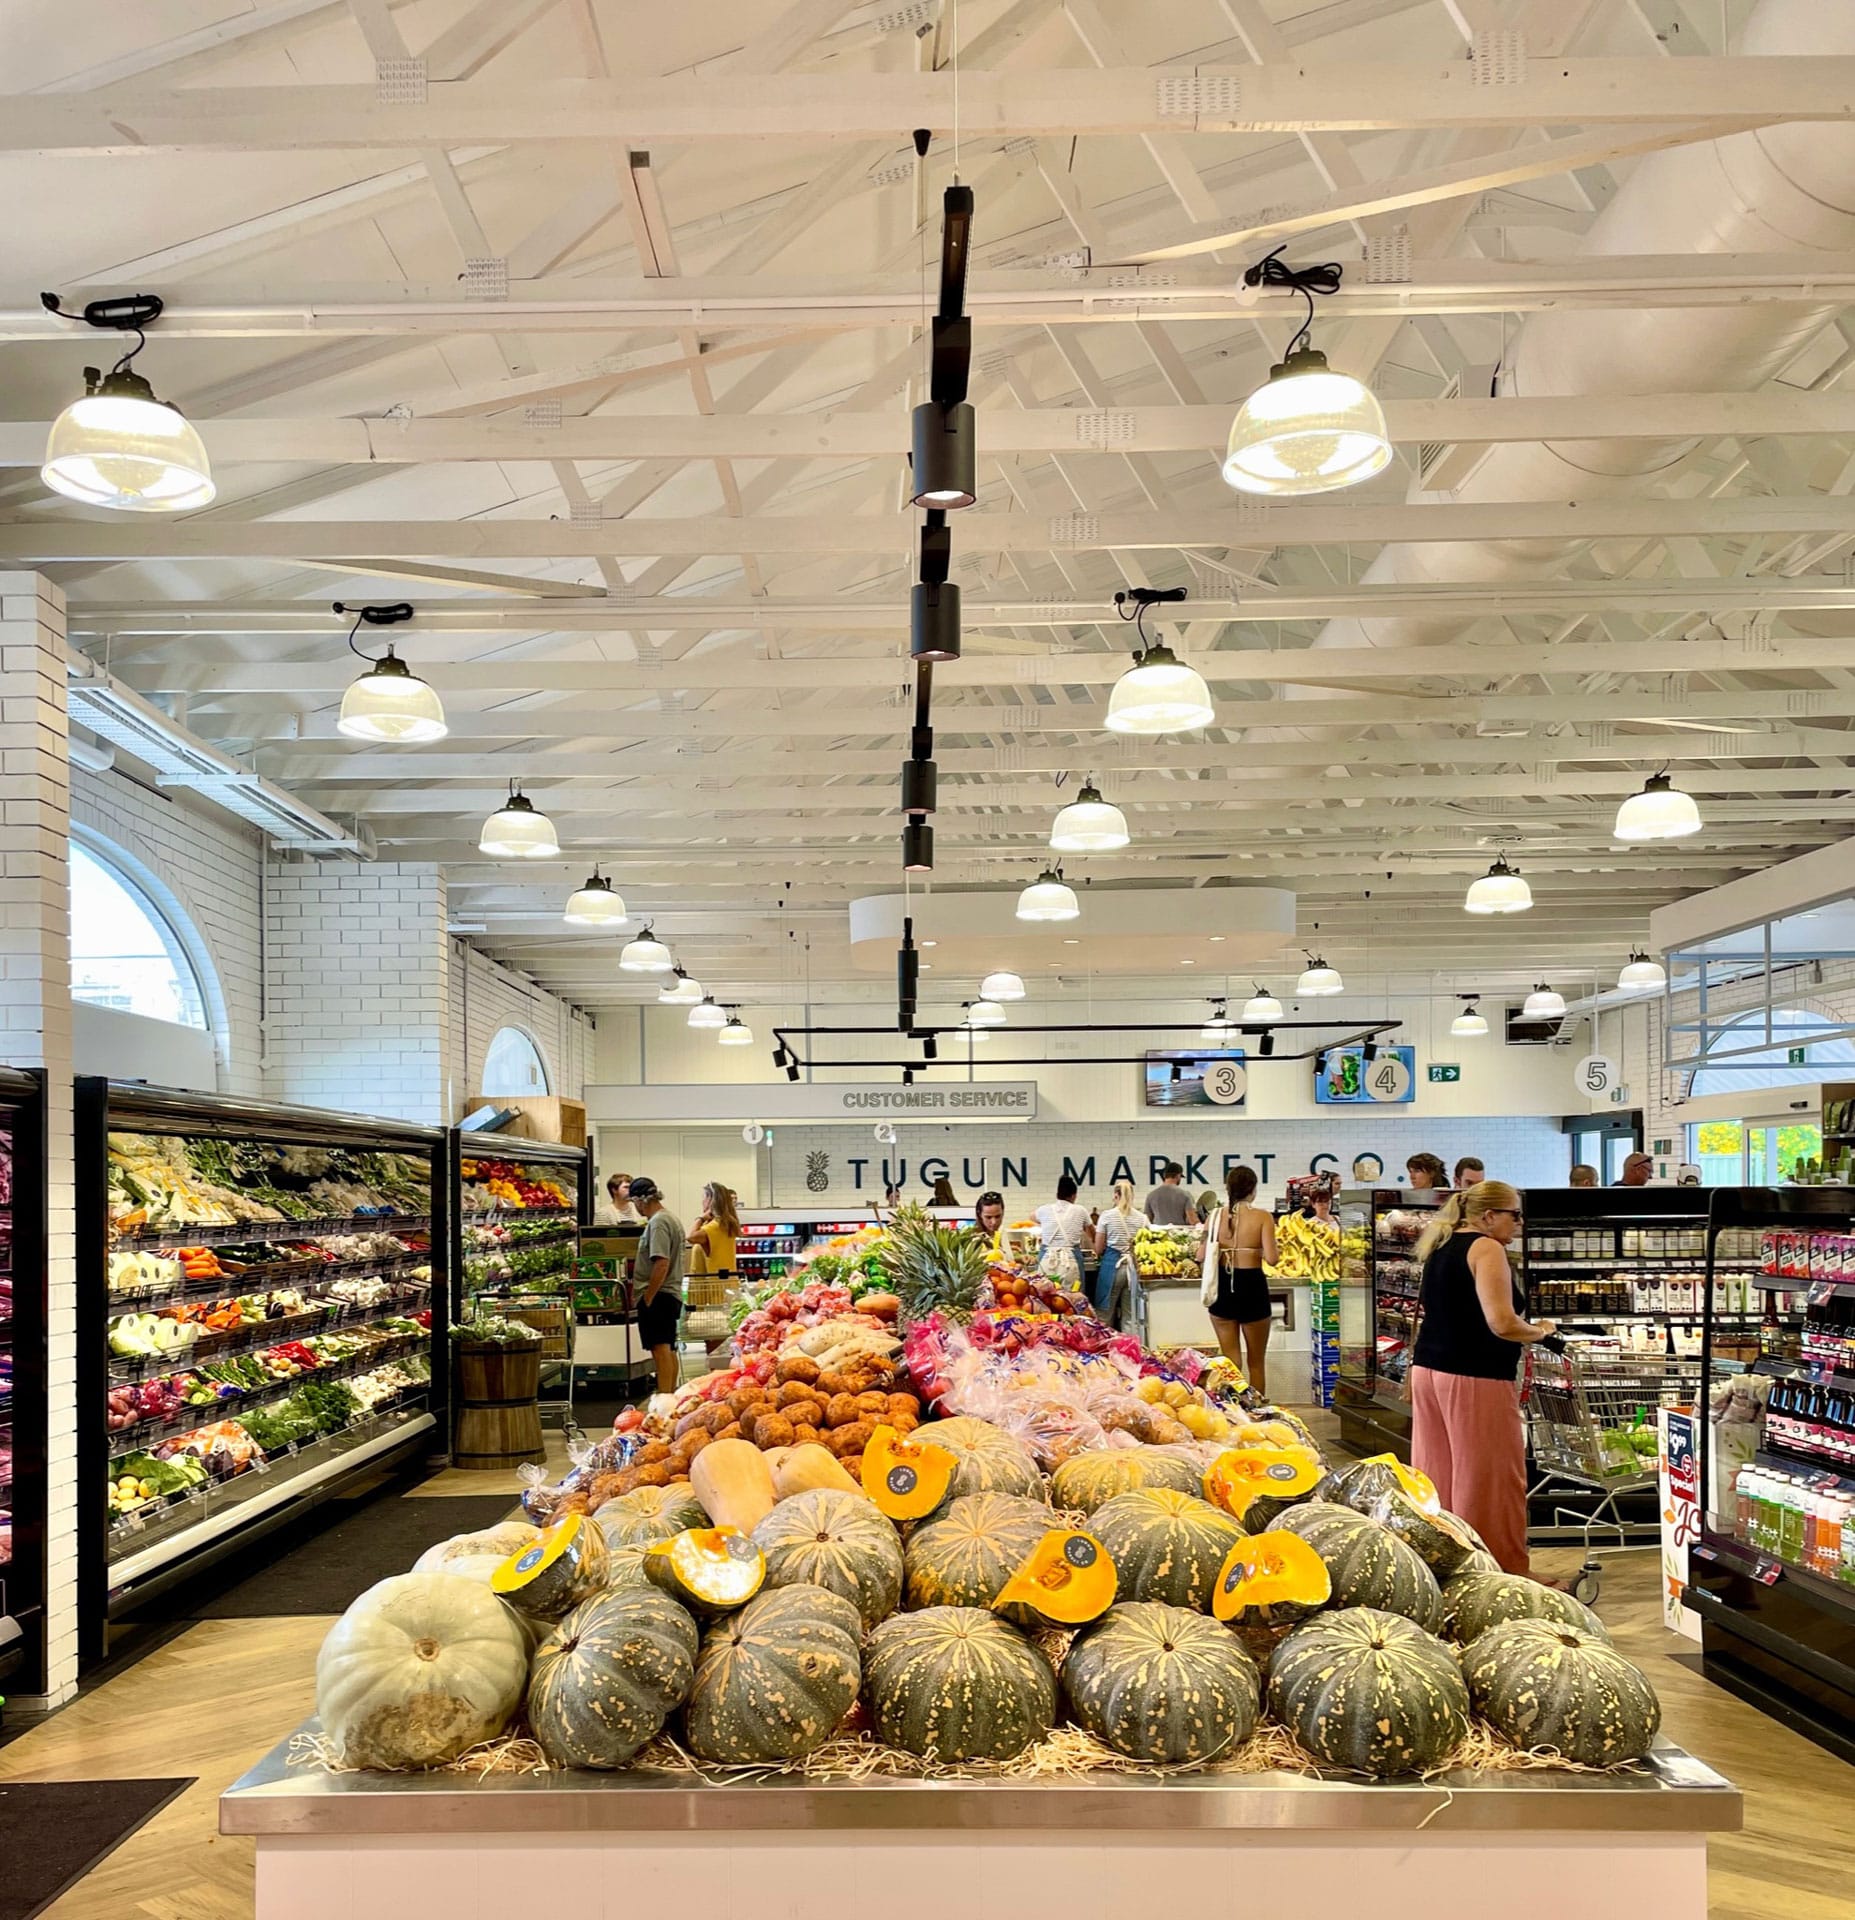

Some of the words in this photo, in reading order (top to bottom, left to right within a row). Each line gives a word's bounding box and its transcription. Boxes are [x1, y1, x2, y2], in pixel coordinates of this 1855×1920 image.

[1215, 1067, 1237, 1097] 3
[1375, 1065, 1397, 1094] 4
[1586, 1061, 1607, 1091] 5
[842, 1092, 945, 1108] CUSTOMER
[949, 1091, 1028, 1107] SERVICE
[748, 1125, 757, 1141] 1
[879, 1124, 891, 1140] 2
[847, 1157, 1028, 1189] TUGUN
